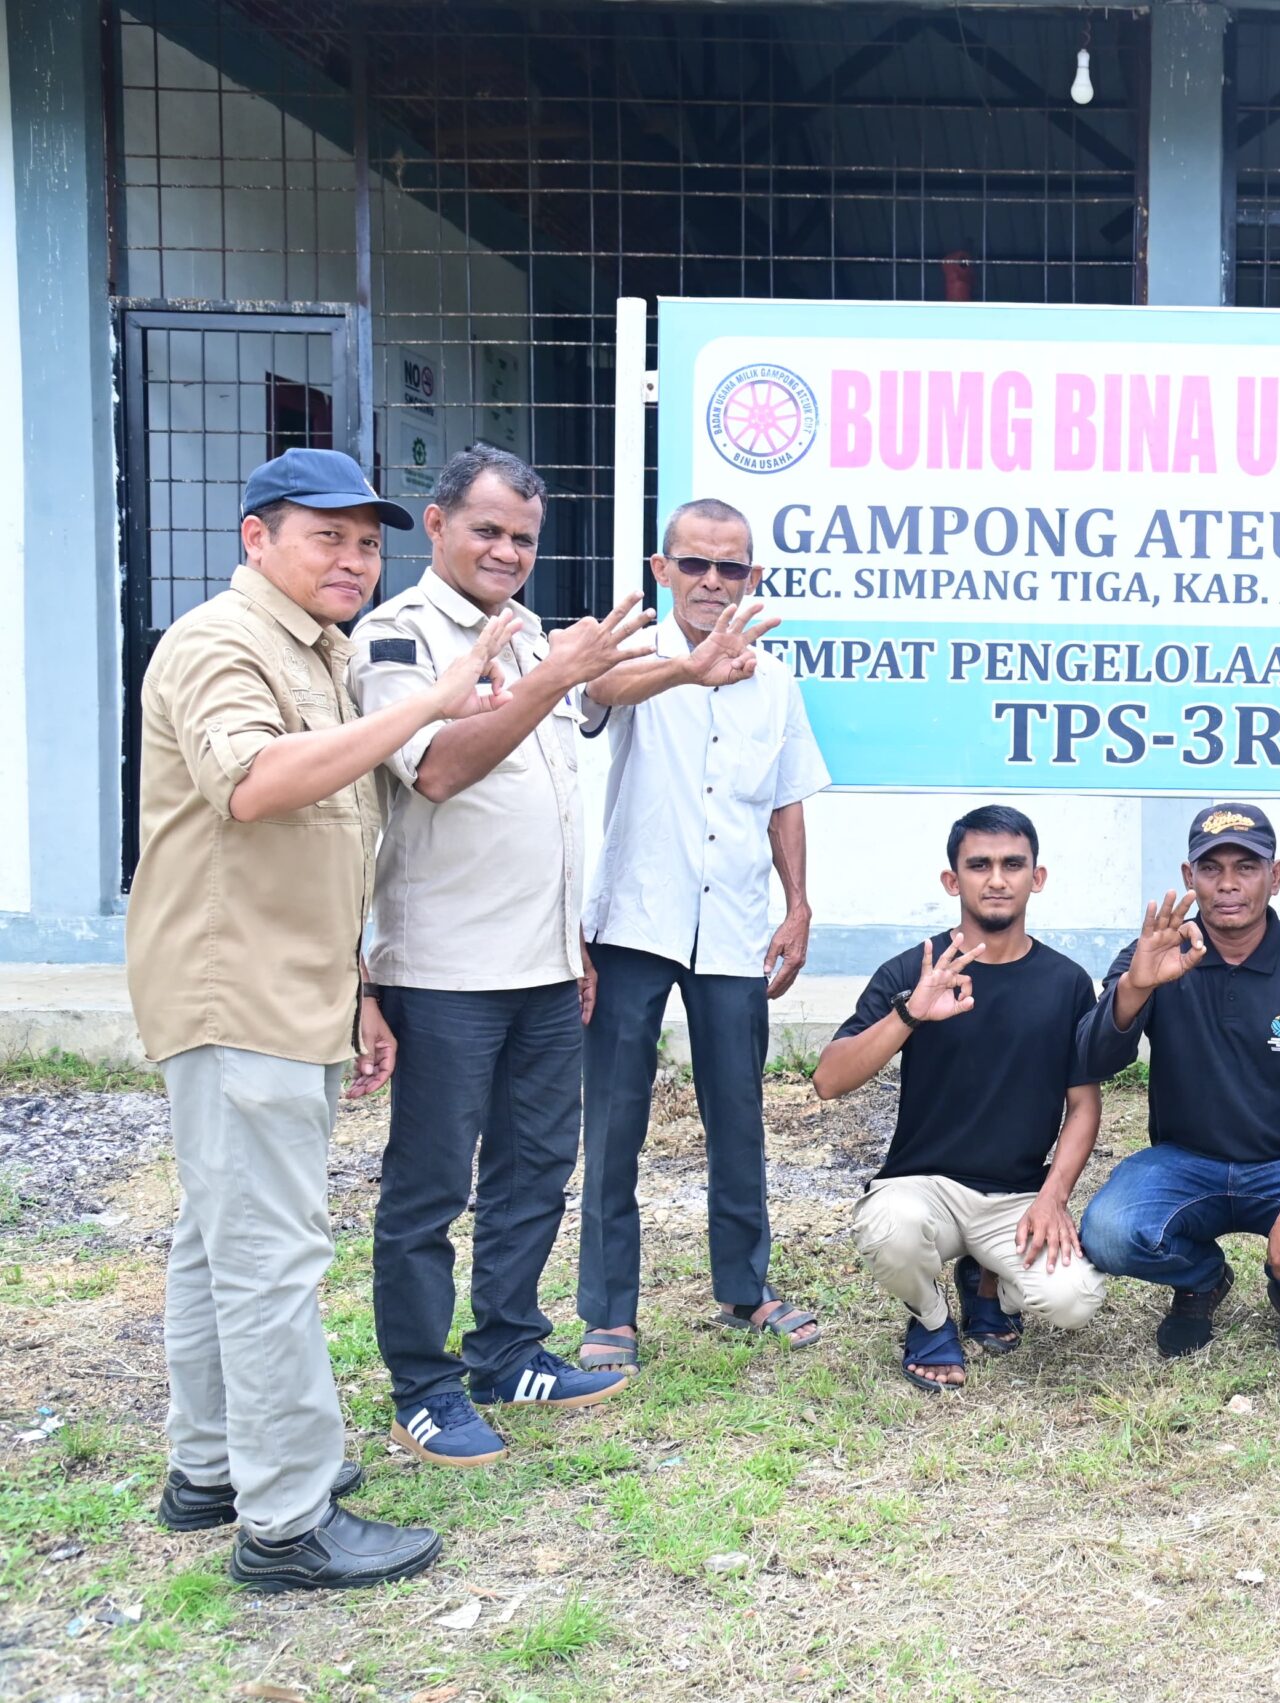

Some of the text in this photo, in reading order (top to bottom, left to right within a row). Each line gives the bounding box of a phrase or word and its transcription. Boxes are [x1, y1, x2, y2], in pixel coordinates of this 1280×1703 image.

[404, 360, 420, 388] NO
[829, 369, 1033, 474] BUMG
[1054, 371, 1217, 475] BINA
[732, 452, 794, 470] BINA USAHA
[772, 504, 1117, 558] GAMPONG
[753, 566, 842, 599] KEC.
[854, 567, 1038, 602] SIMPANG
[1051, 571, 1161, 609] TIGA,
[1174, 573, 1269, 605] KAB.
